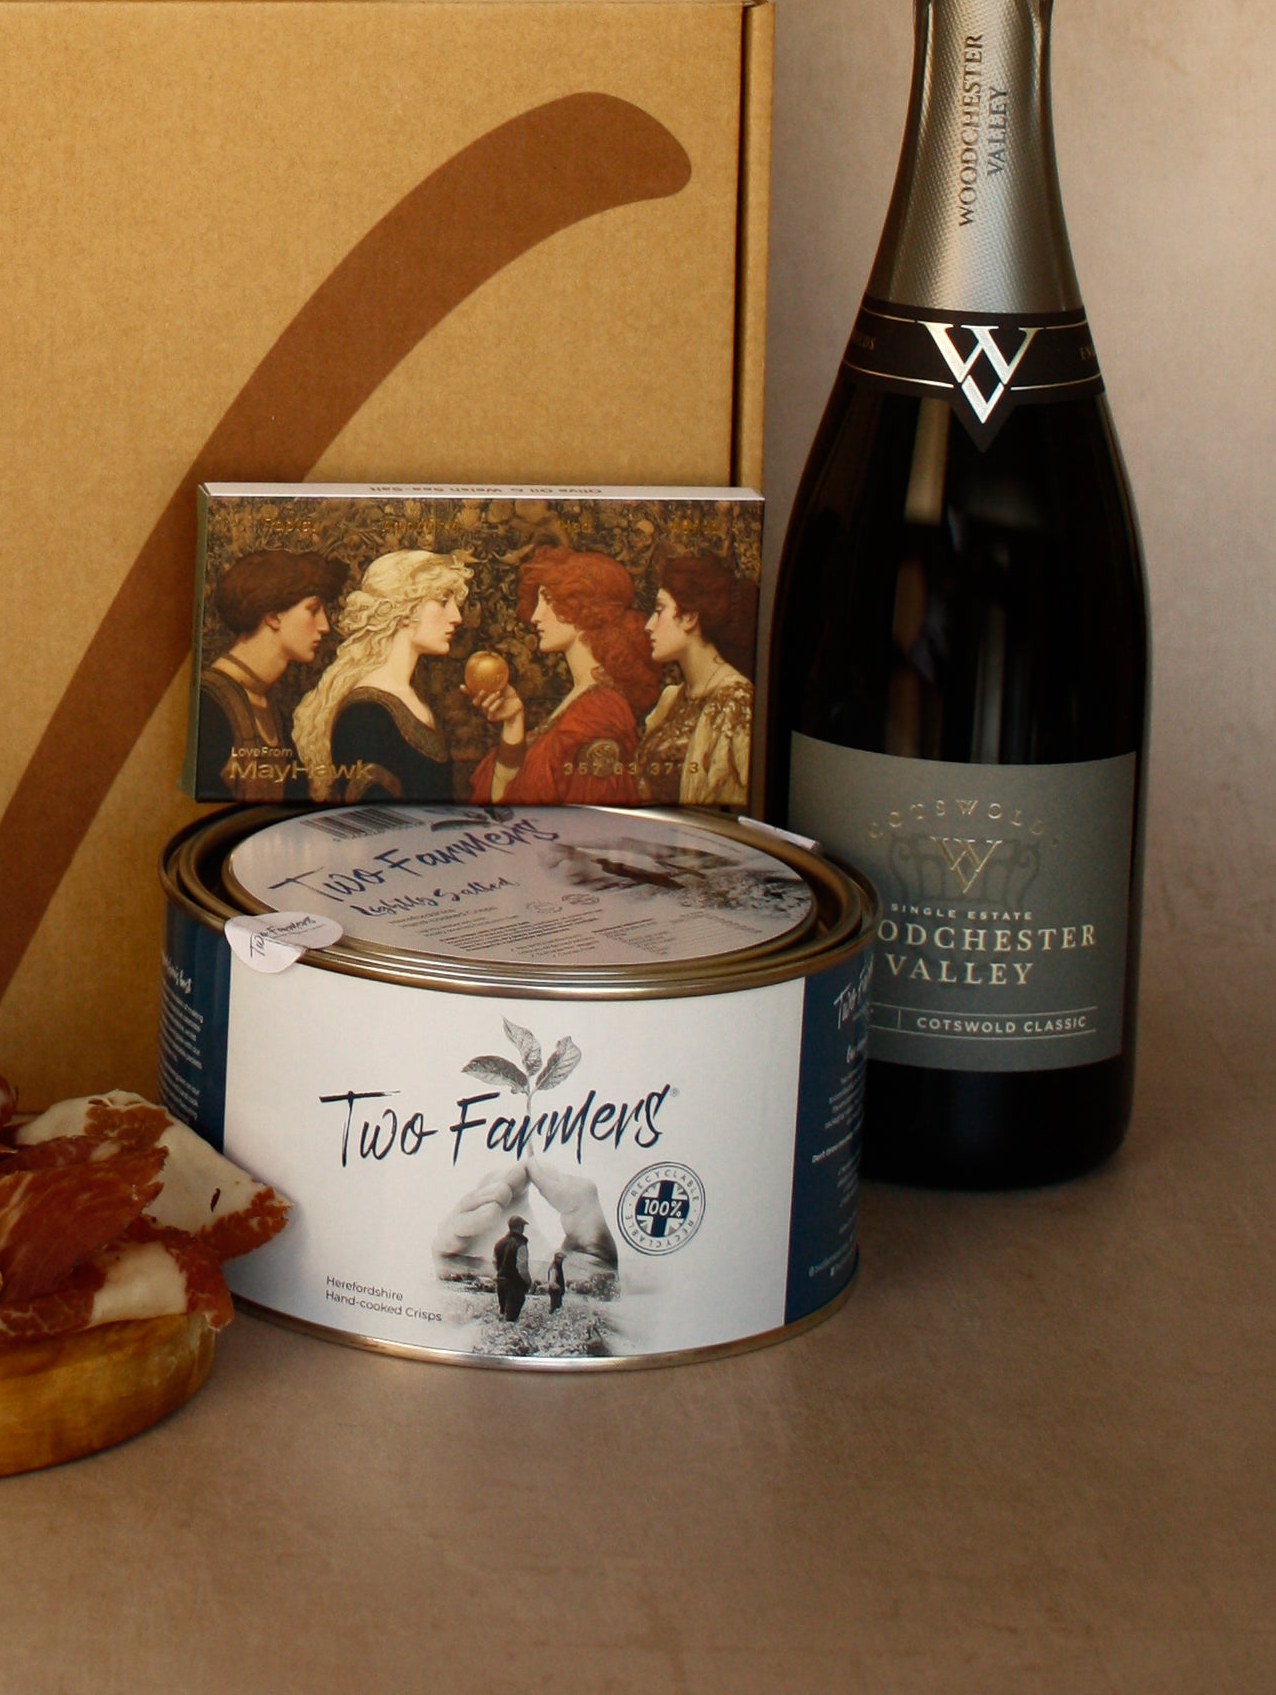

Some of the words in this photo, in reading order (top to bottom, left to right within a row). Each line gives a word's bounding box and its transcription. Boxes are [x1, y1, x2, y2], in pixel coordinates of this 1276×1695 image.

[958, 33, 984, 227] WOODCHESTER
[987, 85, 1009, 176] VALLEY
[268, 866, 384, 903] Two
[374, 818, 559, 879] Farmers
[891, 903, 957, 919] SINGLE
[967, 911, 1033, 921] ESTATE
[877, 920, 1096, 953] ODCHESTER
[884, 953, 1035, 986] VALLEY
[916, 1017, 1016, 1034] COTSWOLD
[1024, 1016, 1087, 1033] CLASSIC
[319, 1090, 439, 1168] Two
[449, 1084, 670, 1167] Farmers
[630, 1168, 700, 1202] RECYCLABLE
[644, 1199, 683, 1218] 100%
[326, 1275, 404, 1302] Herefordshire
[325, 1289, 402, 1316] Hand-cooked
[405, 1306, 443, 1323] Crisps
